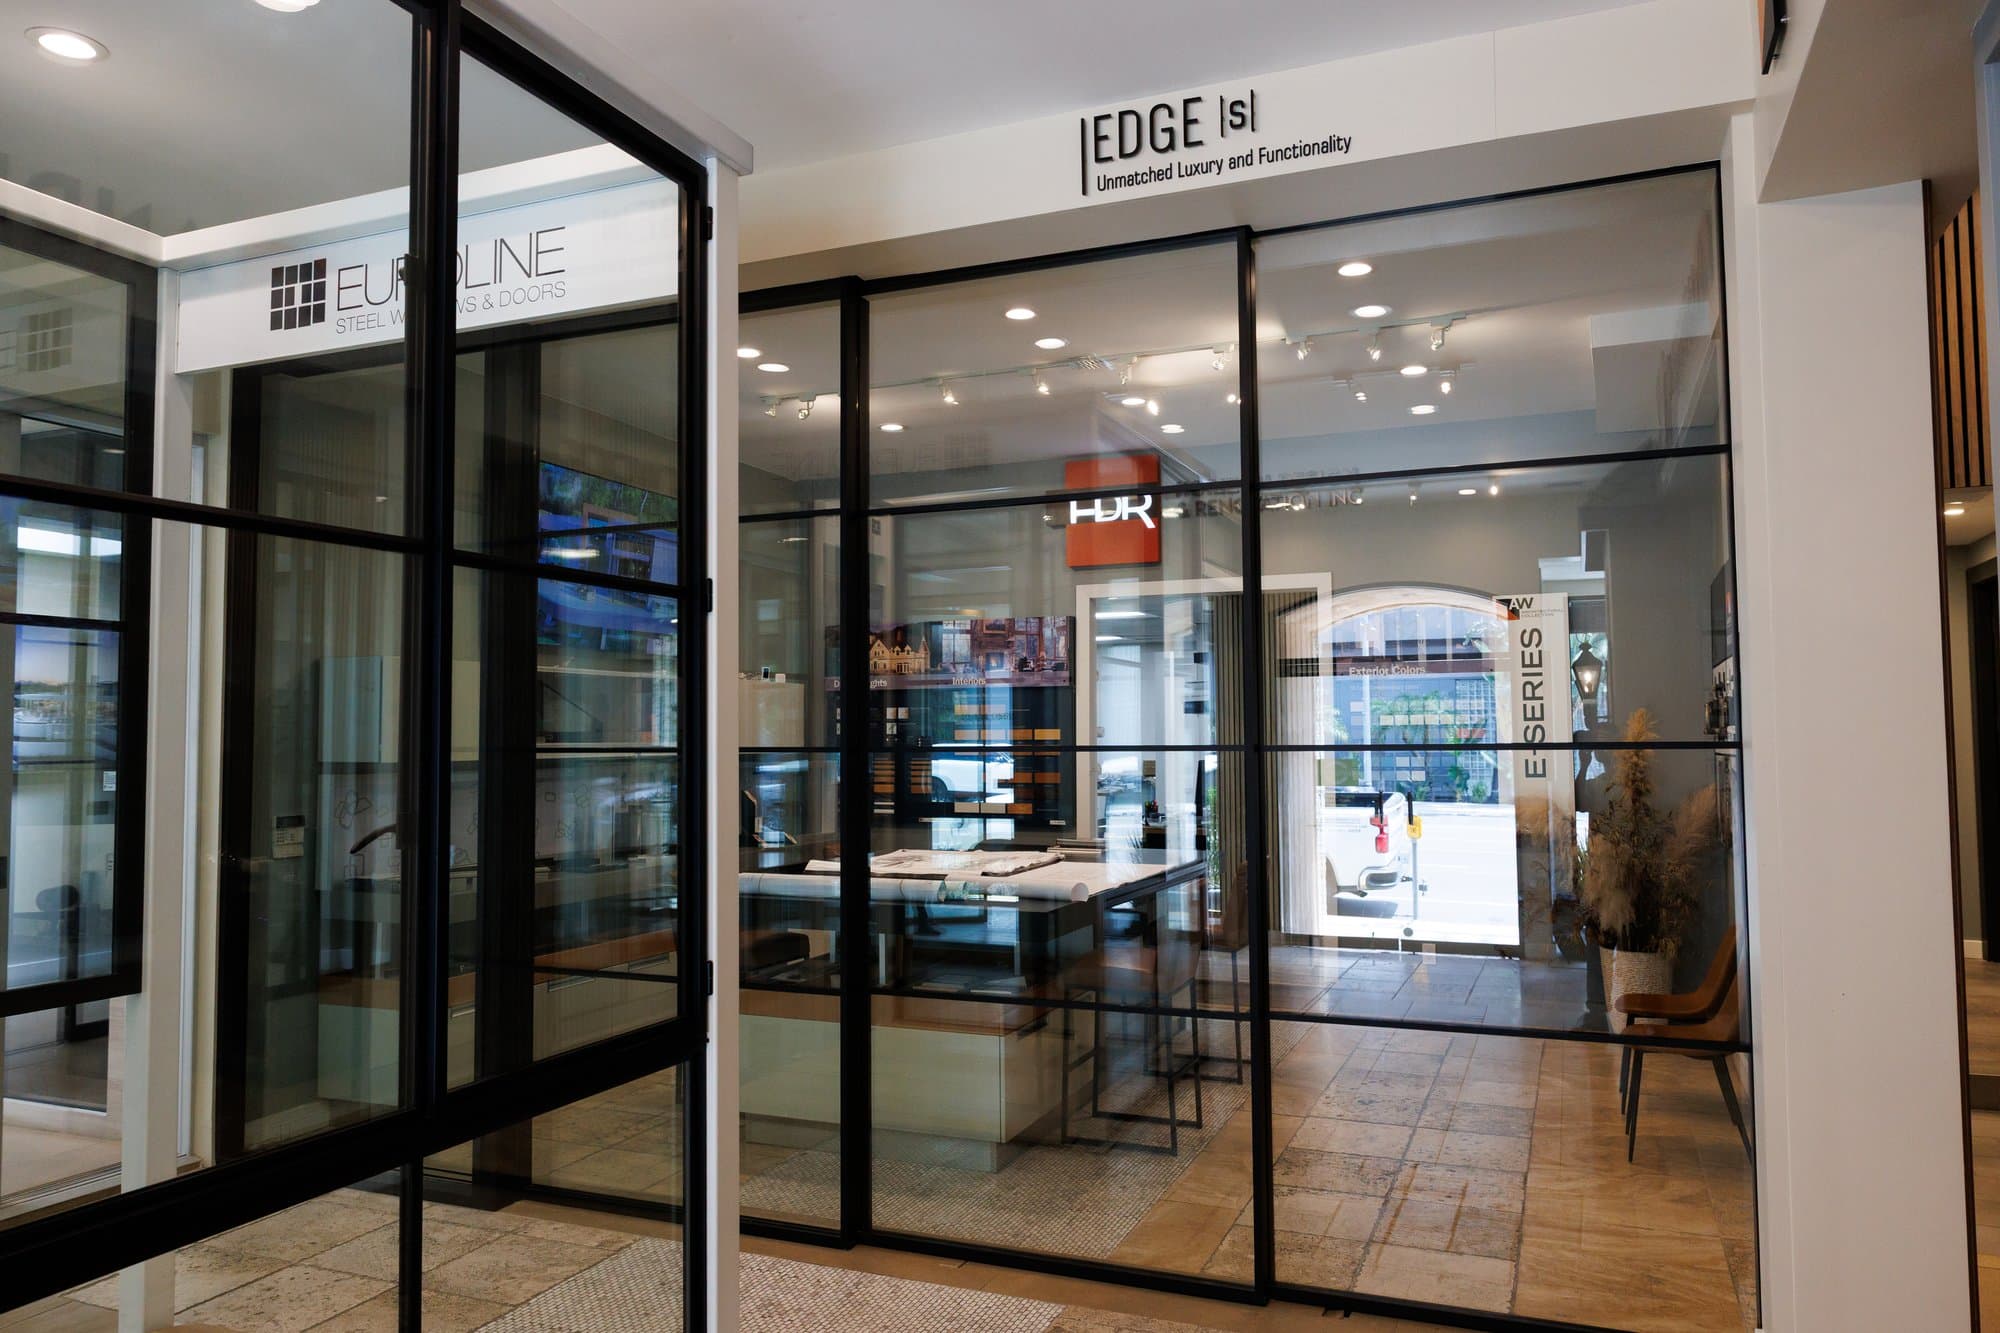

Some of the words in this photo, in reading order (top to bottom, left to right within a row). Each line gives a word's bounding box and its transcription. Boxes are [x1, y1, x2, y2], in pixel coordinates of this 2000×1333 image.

[1097, 163, 1173, 192] Unmatched
[1177, 154, 1224, 178] Luxury
[1228, 149, 1254, 170] and
[1258, 134, 1352, 164] Functionality
[337, 226, 566, 312] EULINE
[335, 311, 386, 335] STEEL
[481, 293, 495, 310] &
[498, 281, 567, 308] DOORS
[951, 676, 986, 686] Interiors
[1349, 666, 1389, 677] Exterior
[1392, 665, 1426, 676] Colors
[1519, 627, 1547, 779] E-SERIES
